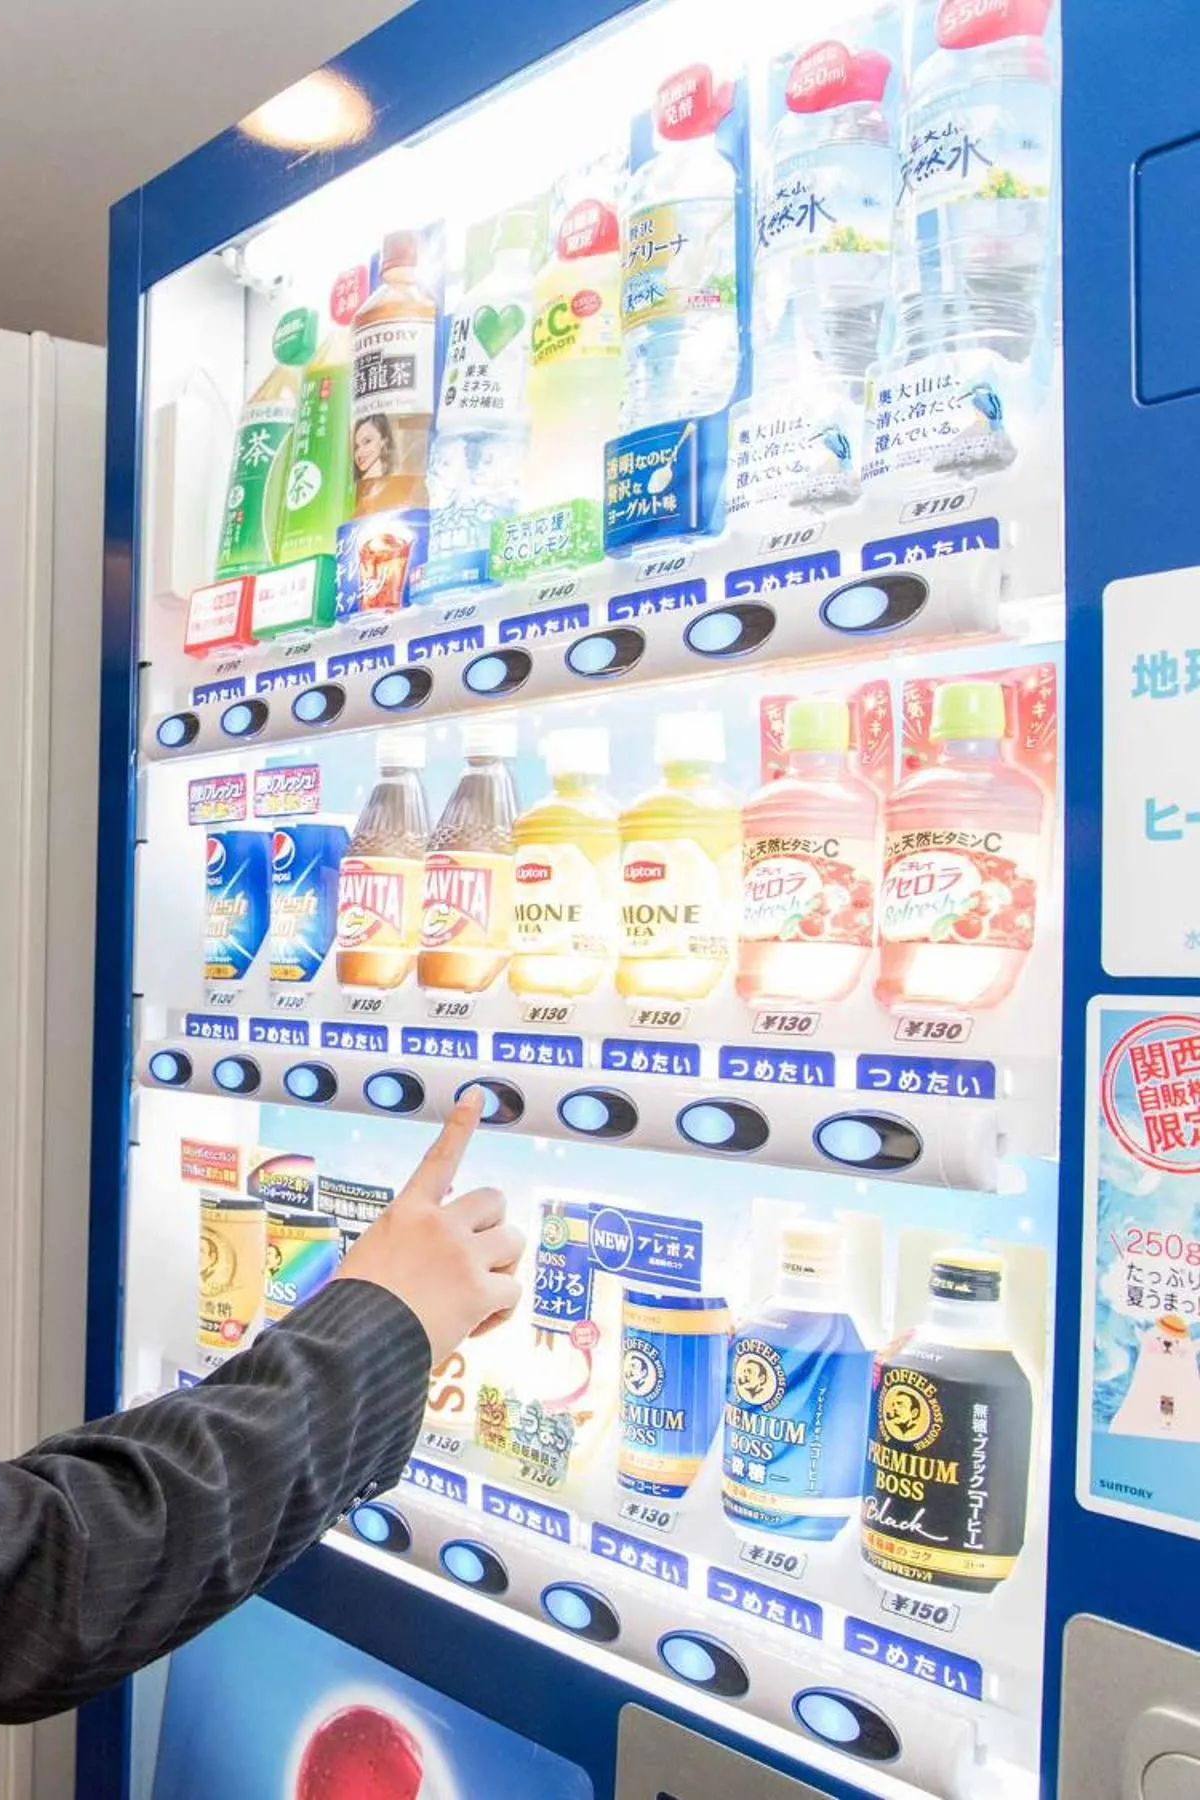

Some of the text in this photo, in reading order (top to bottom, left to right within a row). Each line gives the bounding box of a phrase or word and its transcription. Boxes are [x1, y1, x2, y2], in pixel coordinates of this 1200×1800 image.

[911, 495, 965, 517] ¥110
[769, 528, 815, 549] ¥110
[874, 536, 990, 566] つめたい
[643, 557, 686, 577] ¥140
[735, 567, 830, 596] つめたい
[615, 594, 699, 619] つめたい
[506, 616, 580, 642] つめたい
[414, 638, 478, 662] つめたい
[351, 999, 382, 1012] ¥130
[435, 1003, 469, 1016] ¥130
[530, 1007, 567, 1021] ¥130
[637, 1010, 681, 1026] ¥130
[190, 1022, 235, 1039] つめたい
[254, 1025, 305, 1044] つめたい
[762, 1015, 813, 1032] ¥130
[904, 1019, 963, 1039] ¥130
[326, 1030, 383, 1050] つめたい
[407, 1036, 472, 1057] つめたい
[499, 1042, 574, 1065] つめたい
[609, 1049, 691, 1073] つめたい
[728, 1058, 824, 1084] つめたい
[867, 1068, 981, 1095] つめたい
[594, 1228, 630, 1253] NEW
[536, 1268, 585, 1297] ろける
[1127, 1262, 1200, 1291] たっぷり
[534, 1295, 583, 1316] フェオレ
[883, 1368, 938, 1399] COFFEE
[425, 1433, 461, 1452] ¥130
[730, 1431, 774, 1461] BOSS
[869, 1440, 959, 1485] PREMIUM
[875, 1470, 925, 1501] BOSS
[1100, 1479, 1153, 1499] SUNTORY
[489, 1496, 564, 1537] つめたい
[626, 1502, 671, 1527] ¥130
[864, 1496, 949, 1541] Black
[599, 1537, 680, 1582] つめたい
[748, 1544, 799, 1572] ¥150
[716, 1580, 814, 1626] つめたい
[891, 1593, 950, 1625] ¥150
[855, 1632, 969, 1692] つめたい
